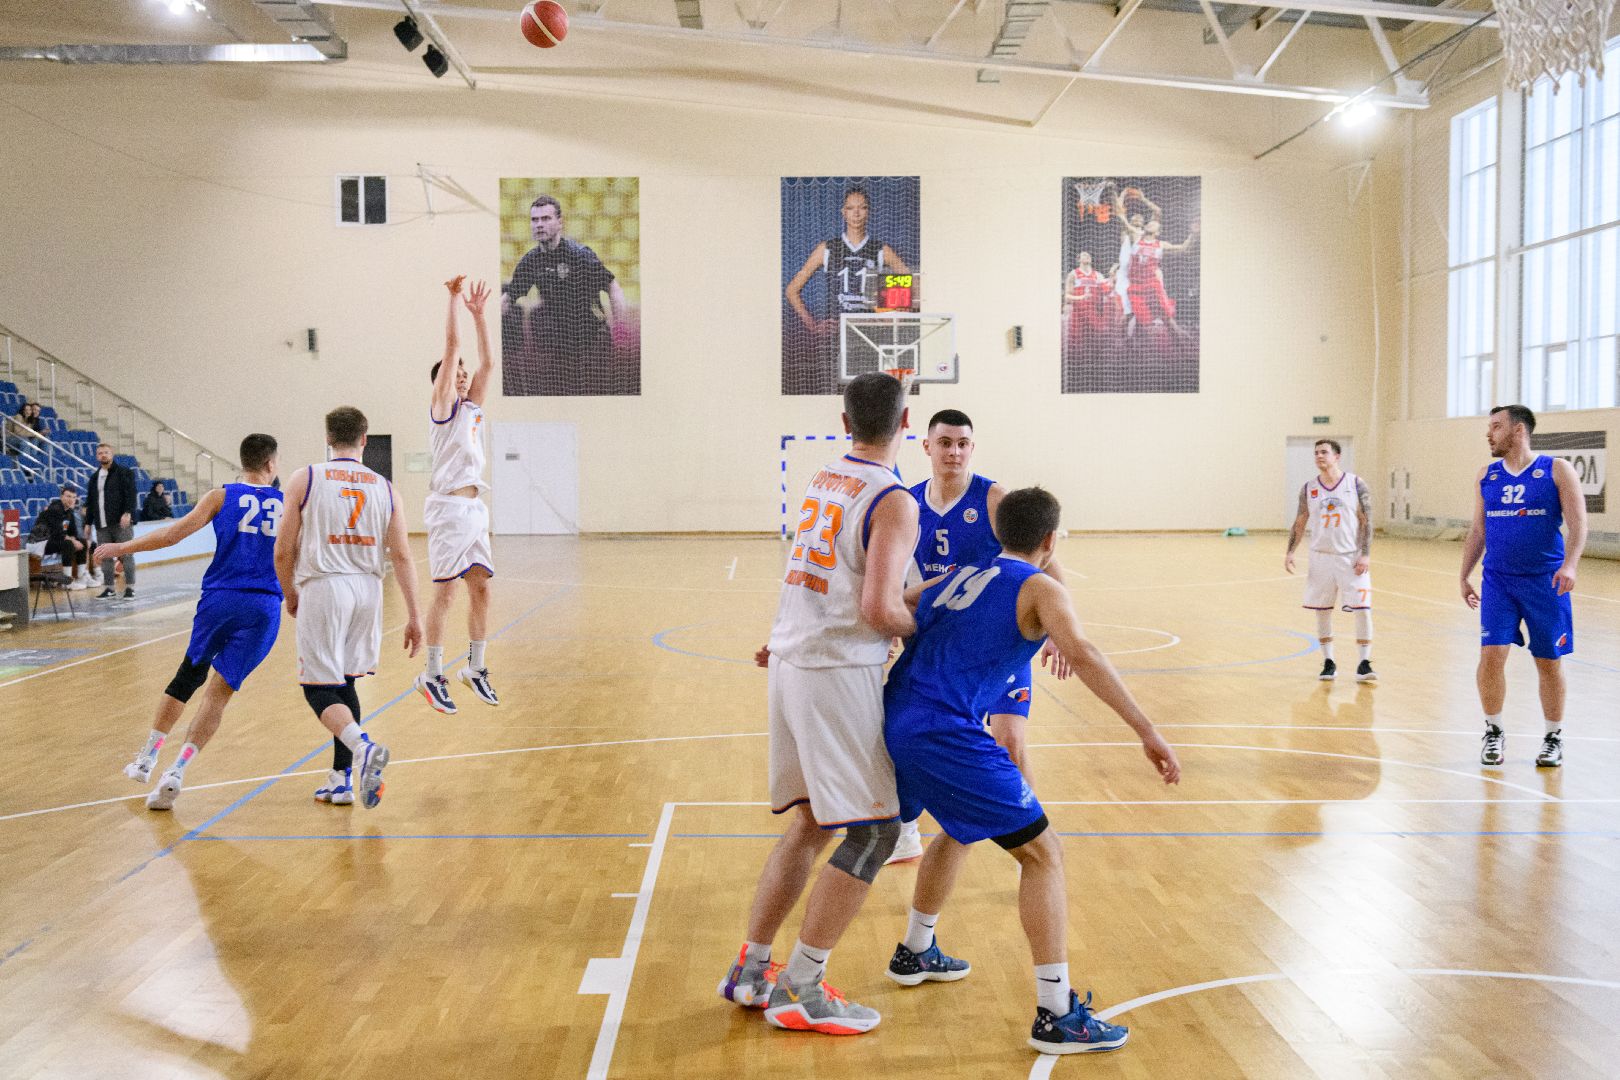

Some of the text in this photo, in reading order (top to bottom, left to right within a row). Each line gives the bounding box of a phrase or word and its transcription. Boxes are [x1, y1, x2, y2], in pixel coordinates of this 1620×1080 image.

[885, 275, 912, 288] 5:49
[1501, 484, 1526, 504] 32
[238, 494, 284, 537] 23
[339, 487, 367, 529] 7
[1321, 513, 1341, 528] 77
[5, 521, 19, 538] 5
[792, 496, 845, 571] 23
[936, 529, 949, 556] 5
[932, 566, 1001, 611] 19
